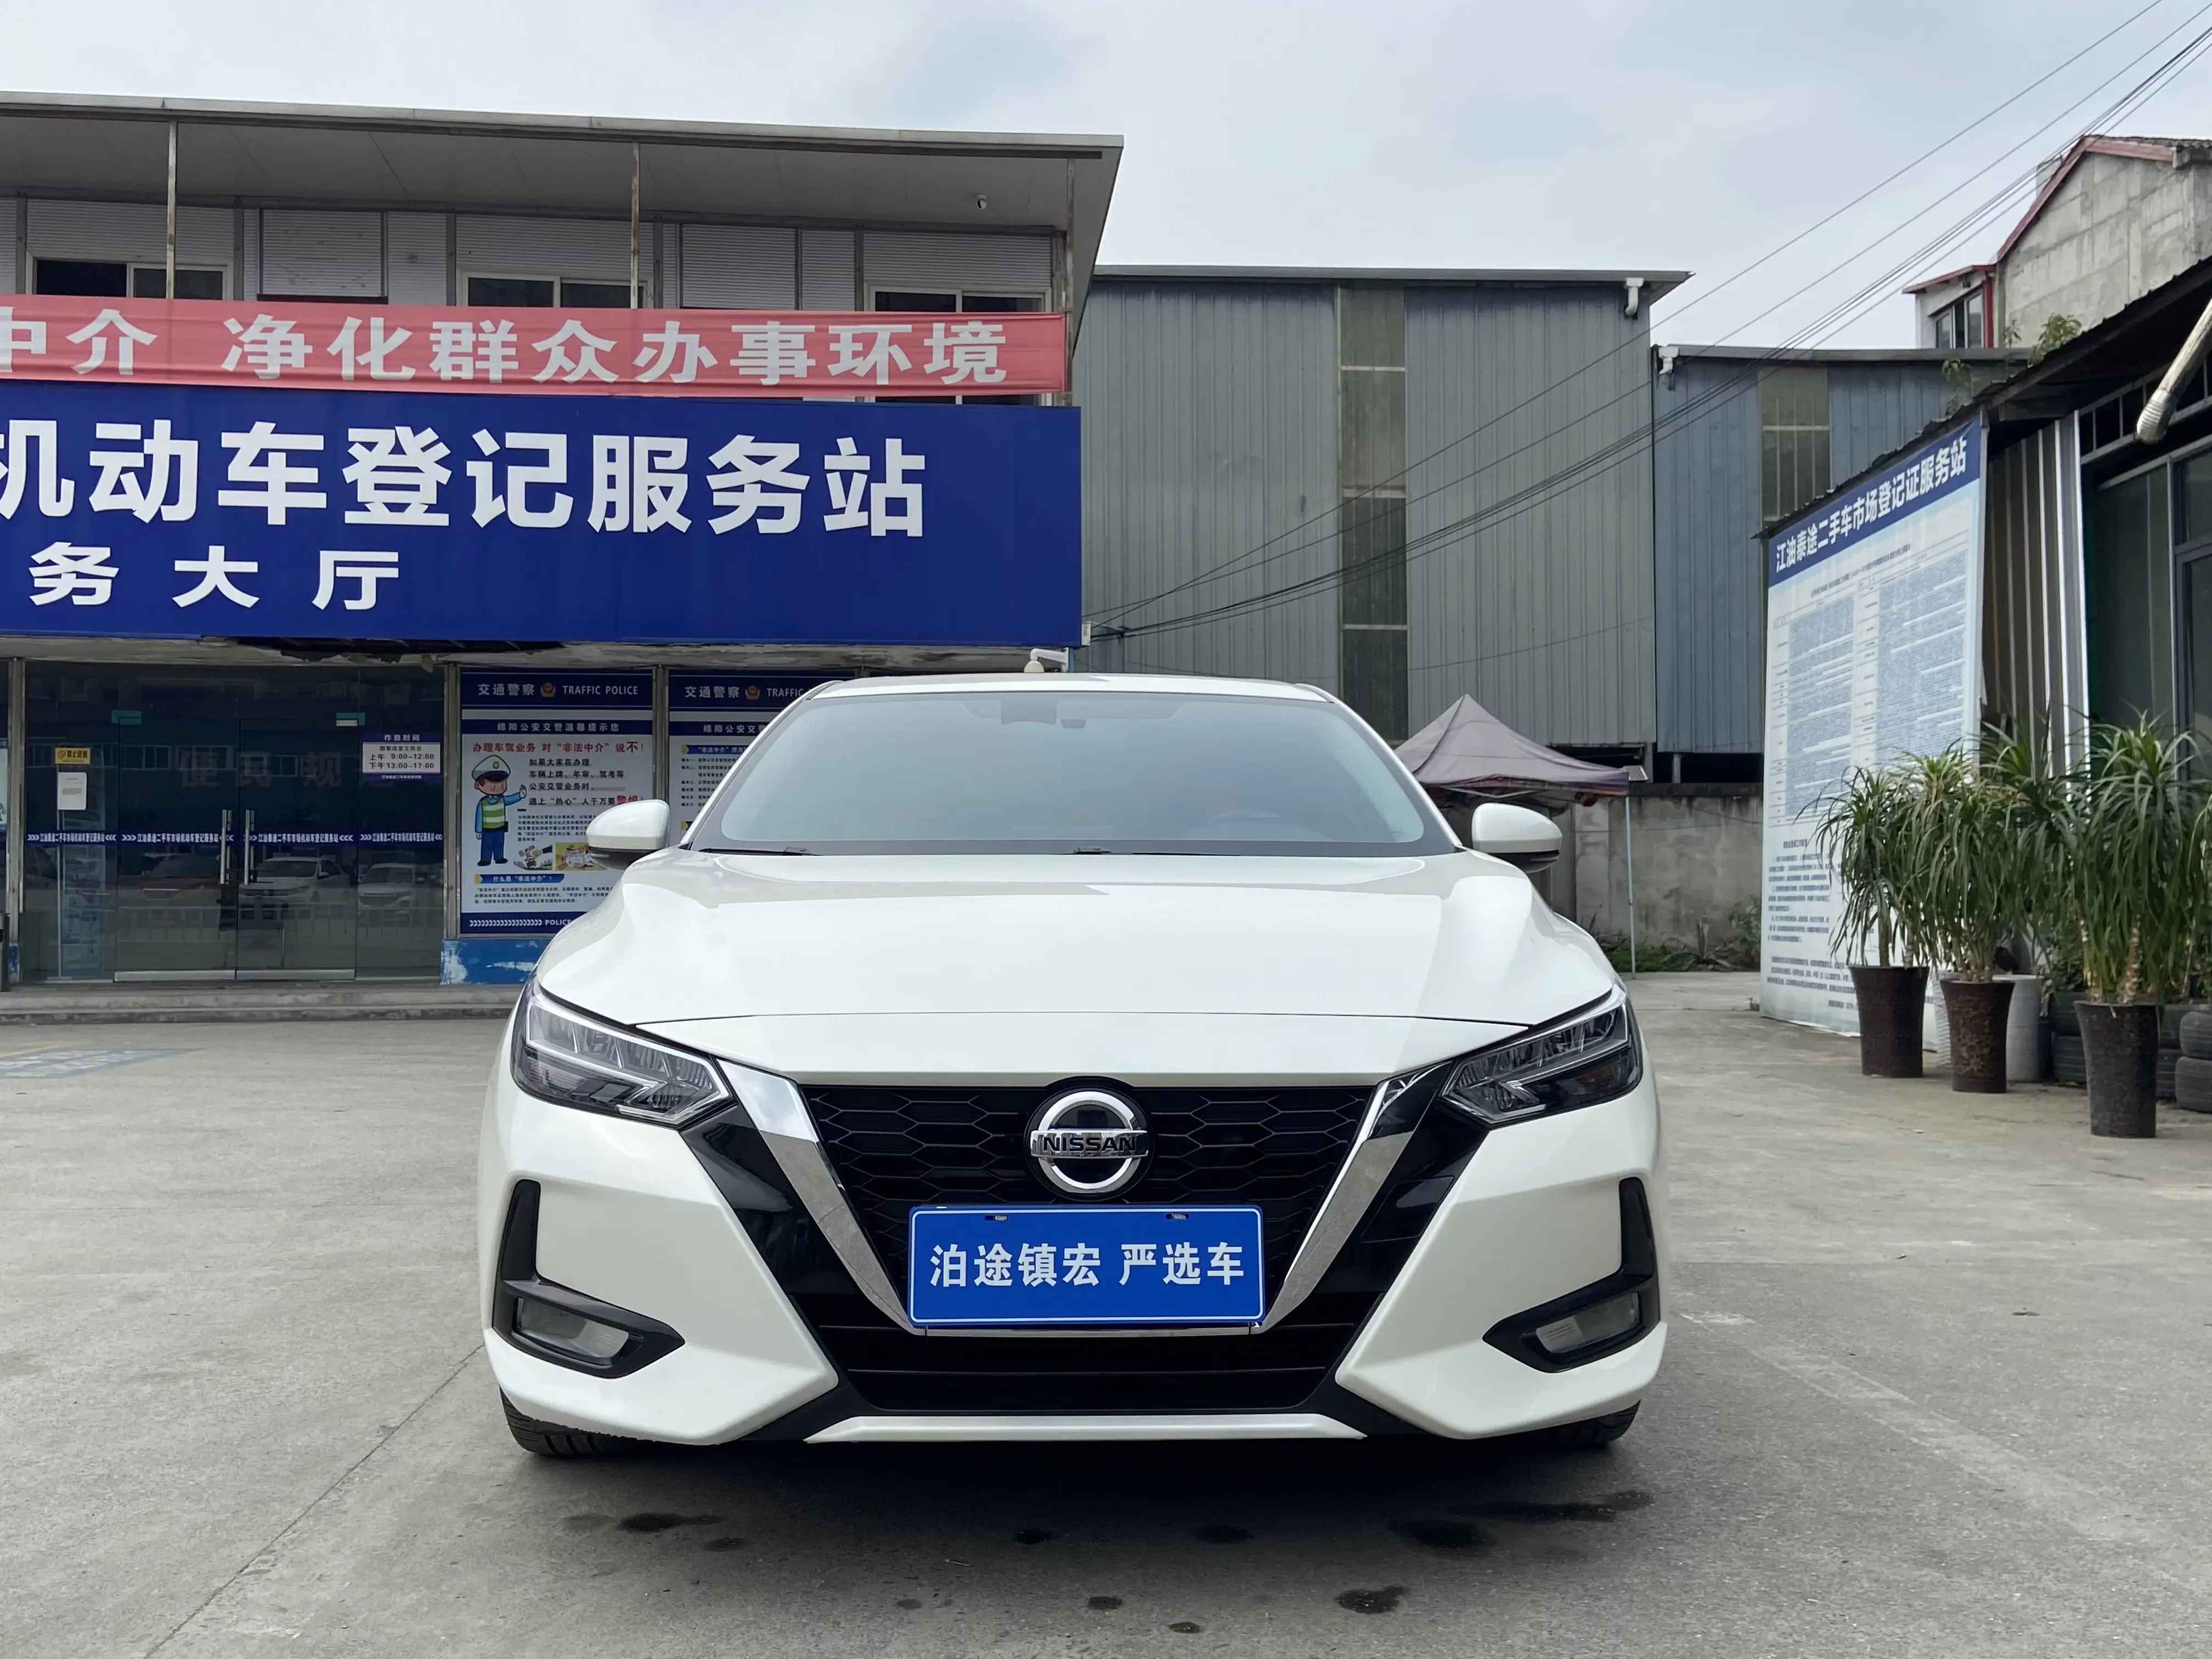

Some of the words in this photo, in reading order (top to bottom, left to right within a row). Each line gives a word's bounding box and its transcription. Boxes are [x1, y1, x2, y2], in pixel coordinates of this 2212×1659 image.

[221, 310, 1006, 387] 净化群众办事环境
[0, 420, 926, 537] 机动车登记服务站
[29, 541, 399, 610] 务大厅
[478, 684, 535, 696] 交通警察
[562, 685, 601, 695] TRAFFIC
[605, 685, 638, 695] POLICE
[685, 686, 740, 698] 交通警察
[767, 688, 804, 697] TRAFFIC
[473, 742, 536, 753] 办理车驾业务
[529, 758, 590, 766] 如果大家在办理
[1043, 1135, 1137, 1152] NISSAN
[930, 1242, 1101, 1288] 泊途镇宏
[1119, 1241, 1245, 1286] 严选车
